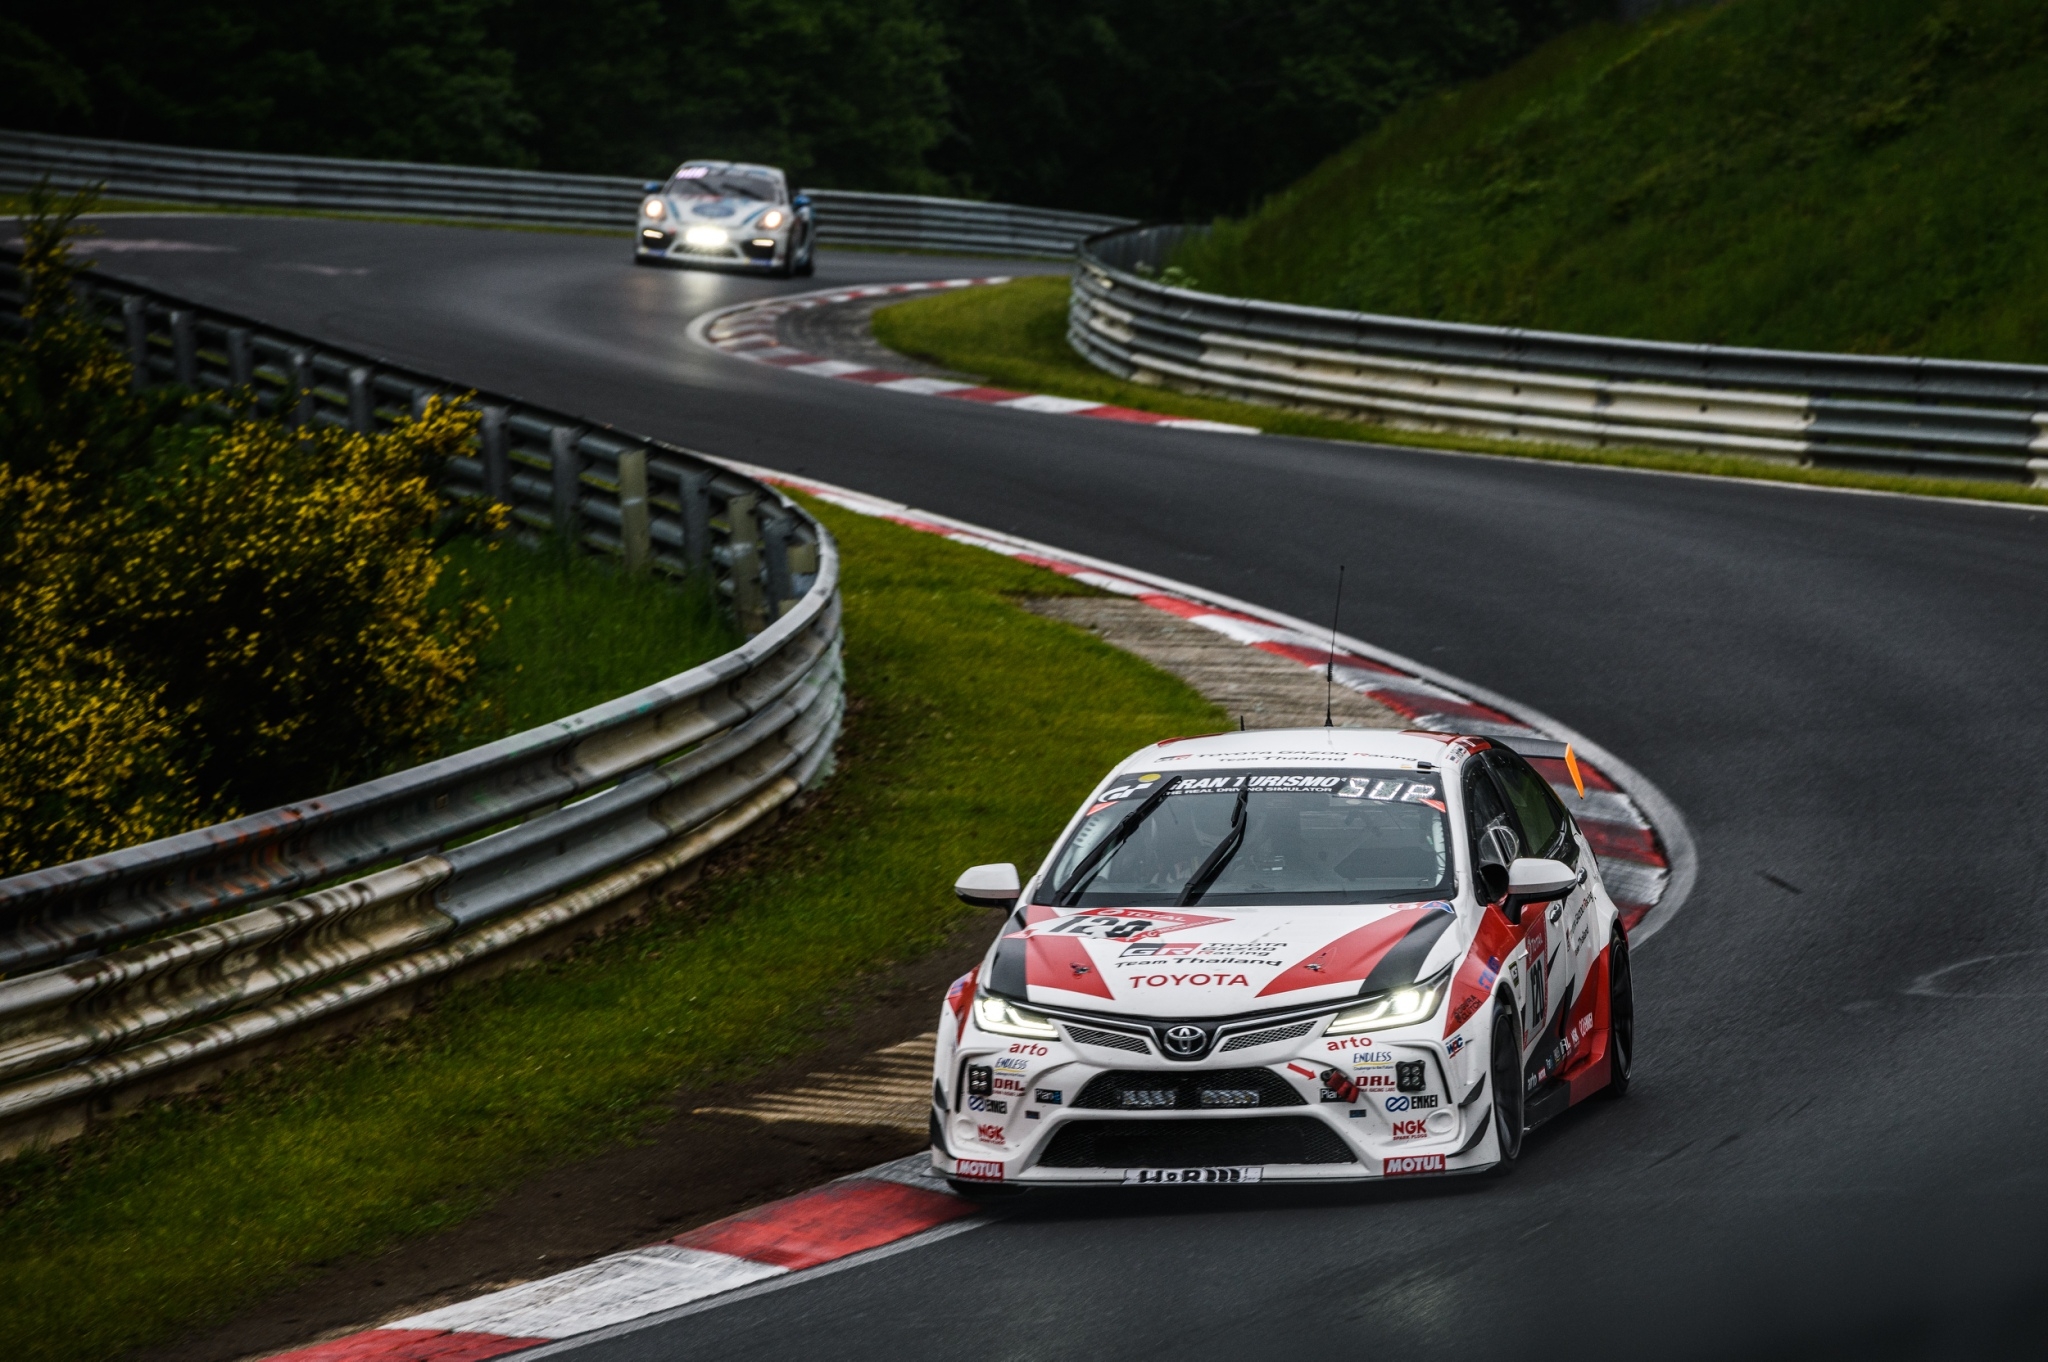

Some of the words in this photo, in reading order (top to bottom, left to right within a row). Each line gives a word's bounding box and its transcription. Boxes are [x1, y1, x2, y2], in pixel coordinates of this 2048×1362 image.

[1353, 752, 1418, 761] Racing
[1233, 775, 1340, 788] TURISMO
[1126, 910, 1186, 921] TOTAL
[1115, 960, 1168, 968] Team
[1173, 957, 1283, 967] Thailand
[1129, 974, 1250, 989] TOYOTA
[1009, 1043, 1048, 1056] arto
[1326, 1036, 1373, 1052] arto
[1353, 1051, 1393, 1064] ENDLESS
[994, 1078, 1026, 1092] DRL
[1355, 1075, 1396, 1087] DRL
[1411, 1094, 1438, 1109] ENKEI
[977, 1124, 1006, 1141] NGK
[1393, 1118, 1427, 1136] NGK
[959, 1160, 1002, 1178] MOTUL
[1386, 1155, 1443, 1173] MOTUL
